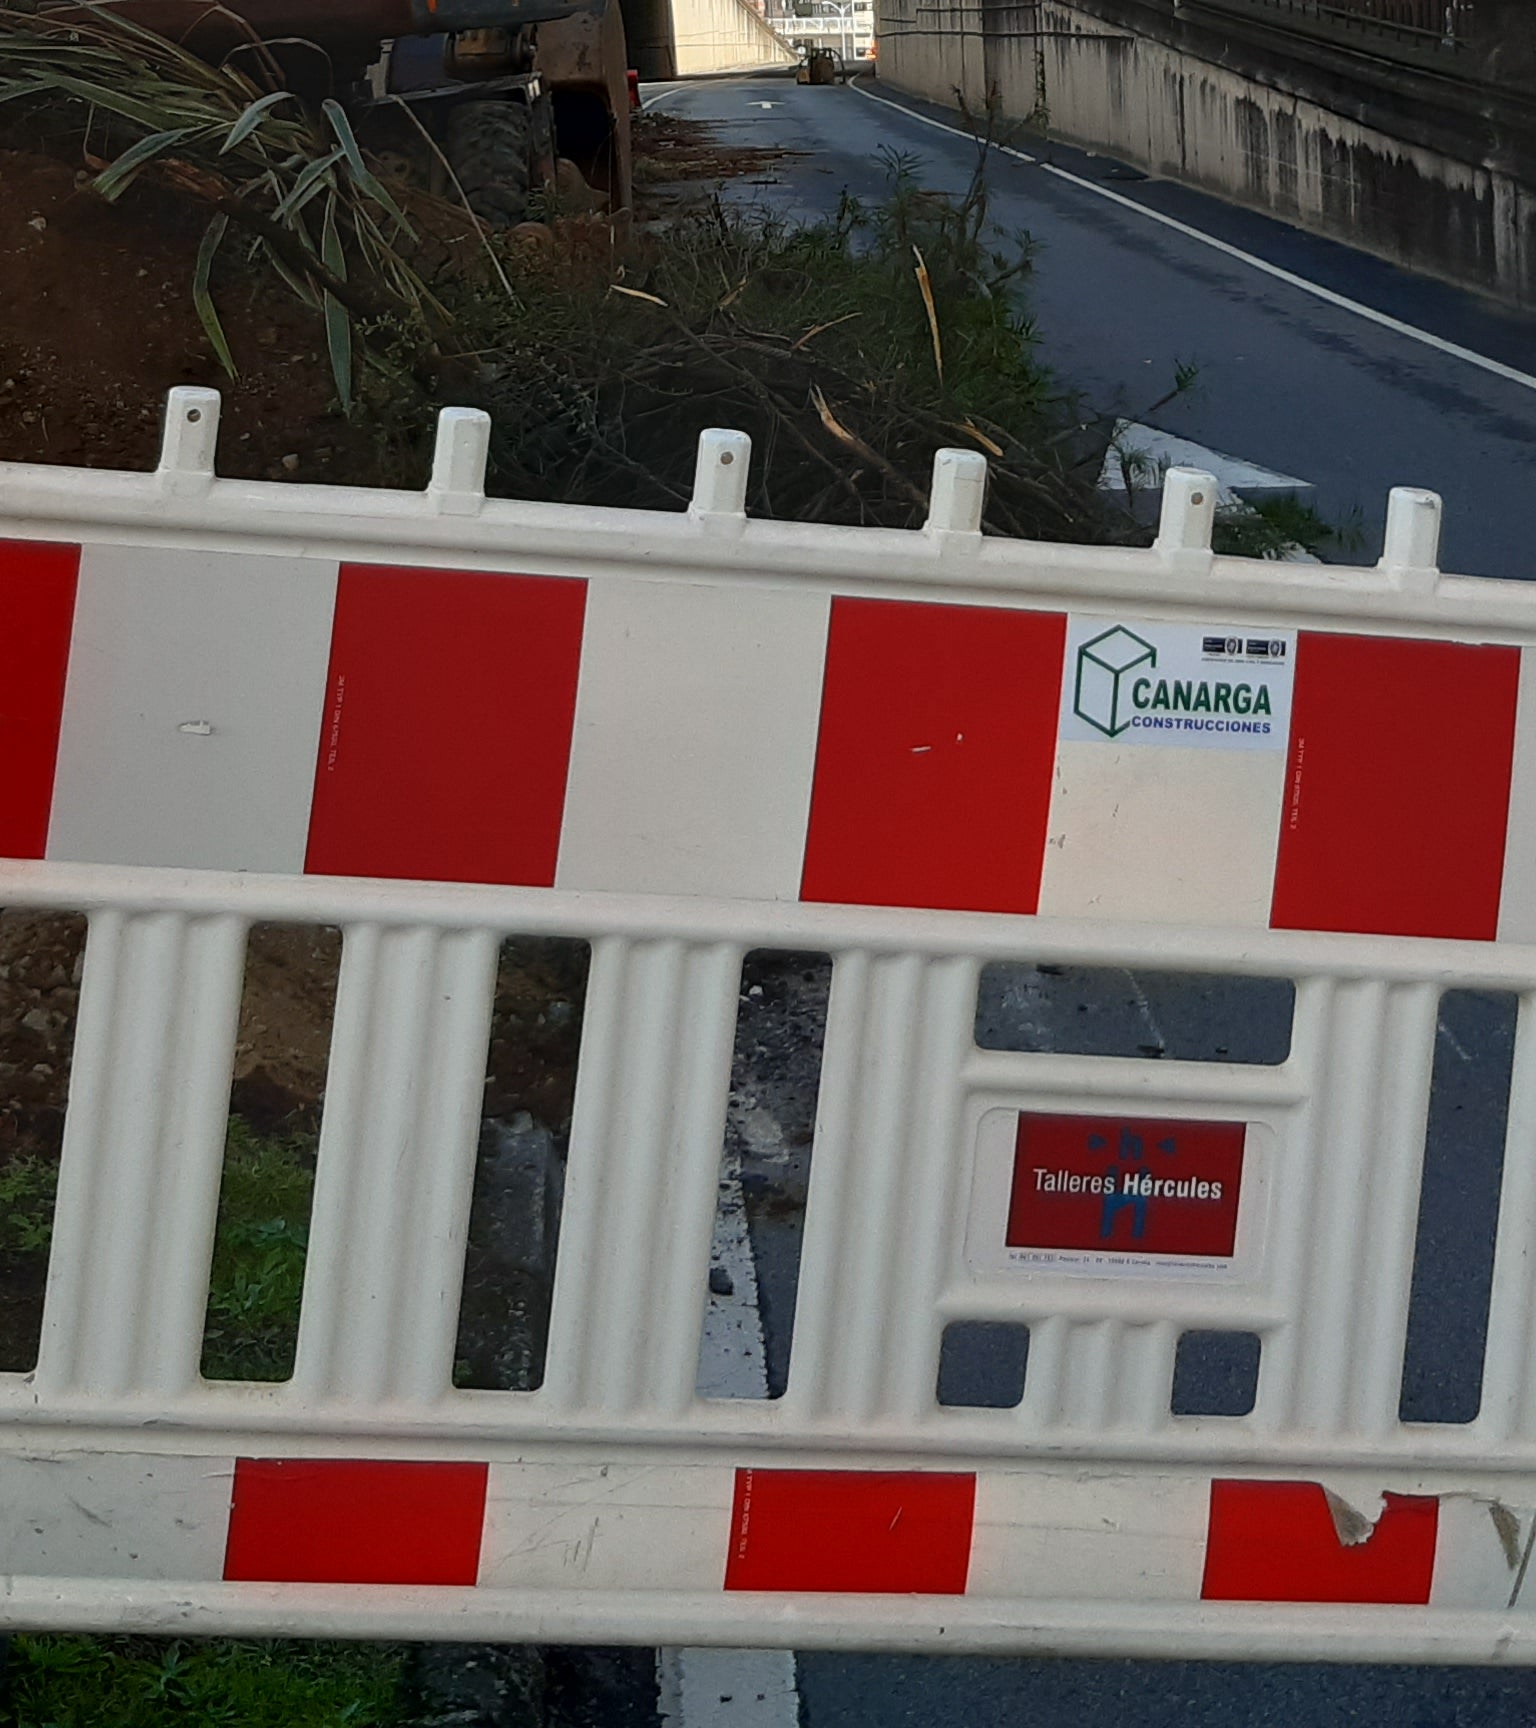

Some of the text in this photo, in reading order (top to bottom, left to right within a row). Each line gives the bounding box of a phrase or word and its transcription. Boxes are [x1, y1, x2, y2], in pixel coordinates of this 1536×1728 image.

[1131, 677, 1272, 716] CANARGA
[1131, 715, 1272, 734] CONSTRUCCIONES
[1033, 1168, 1222, 1200] Talleres Hércules
